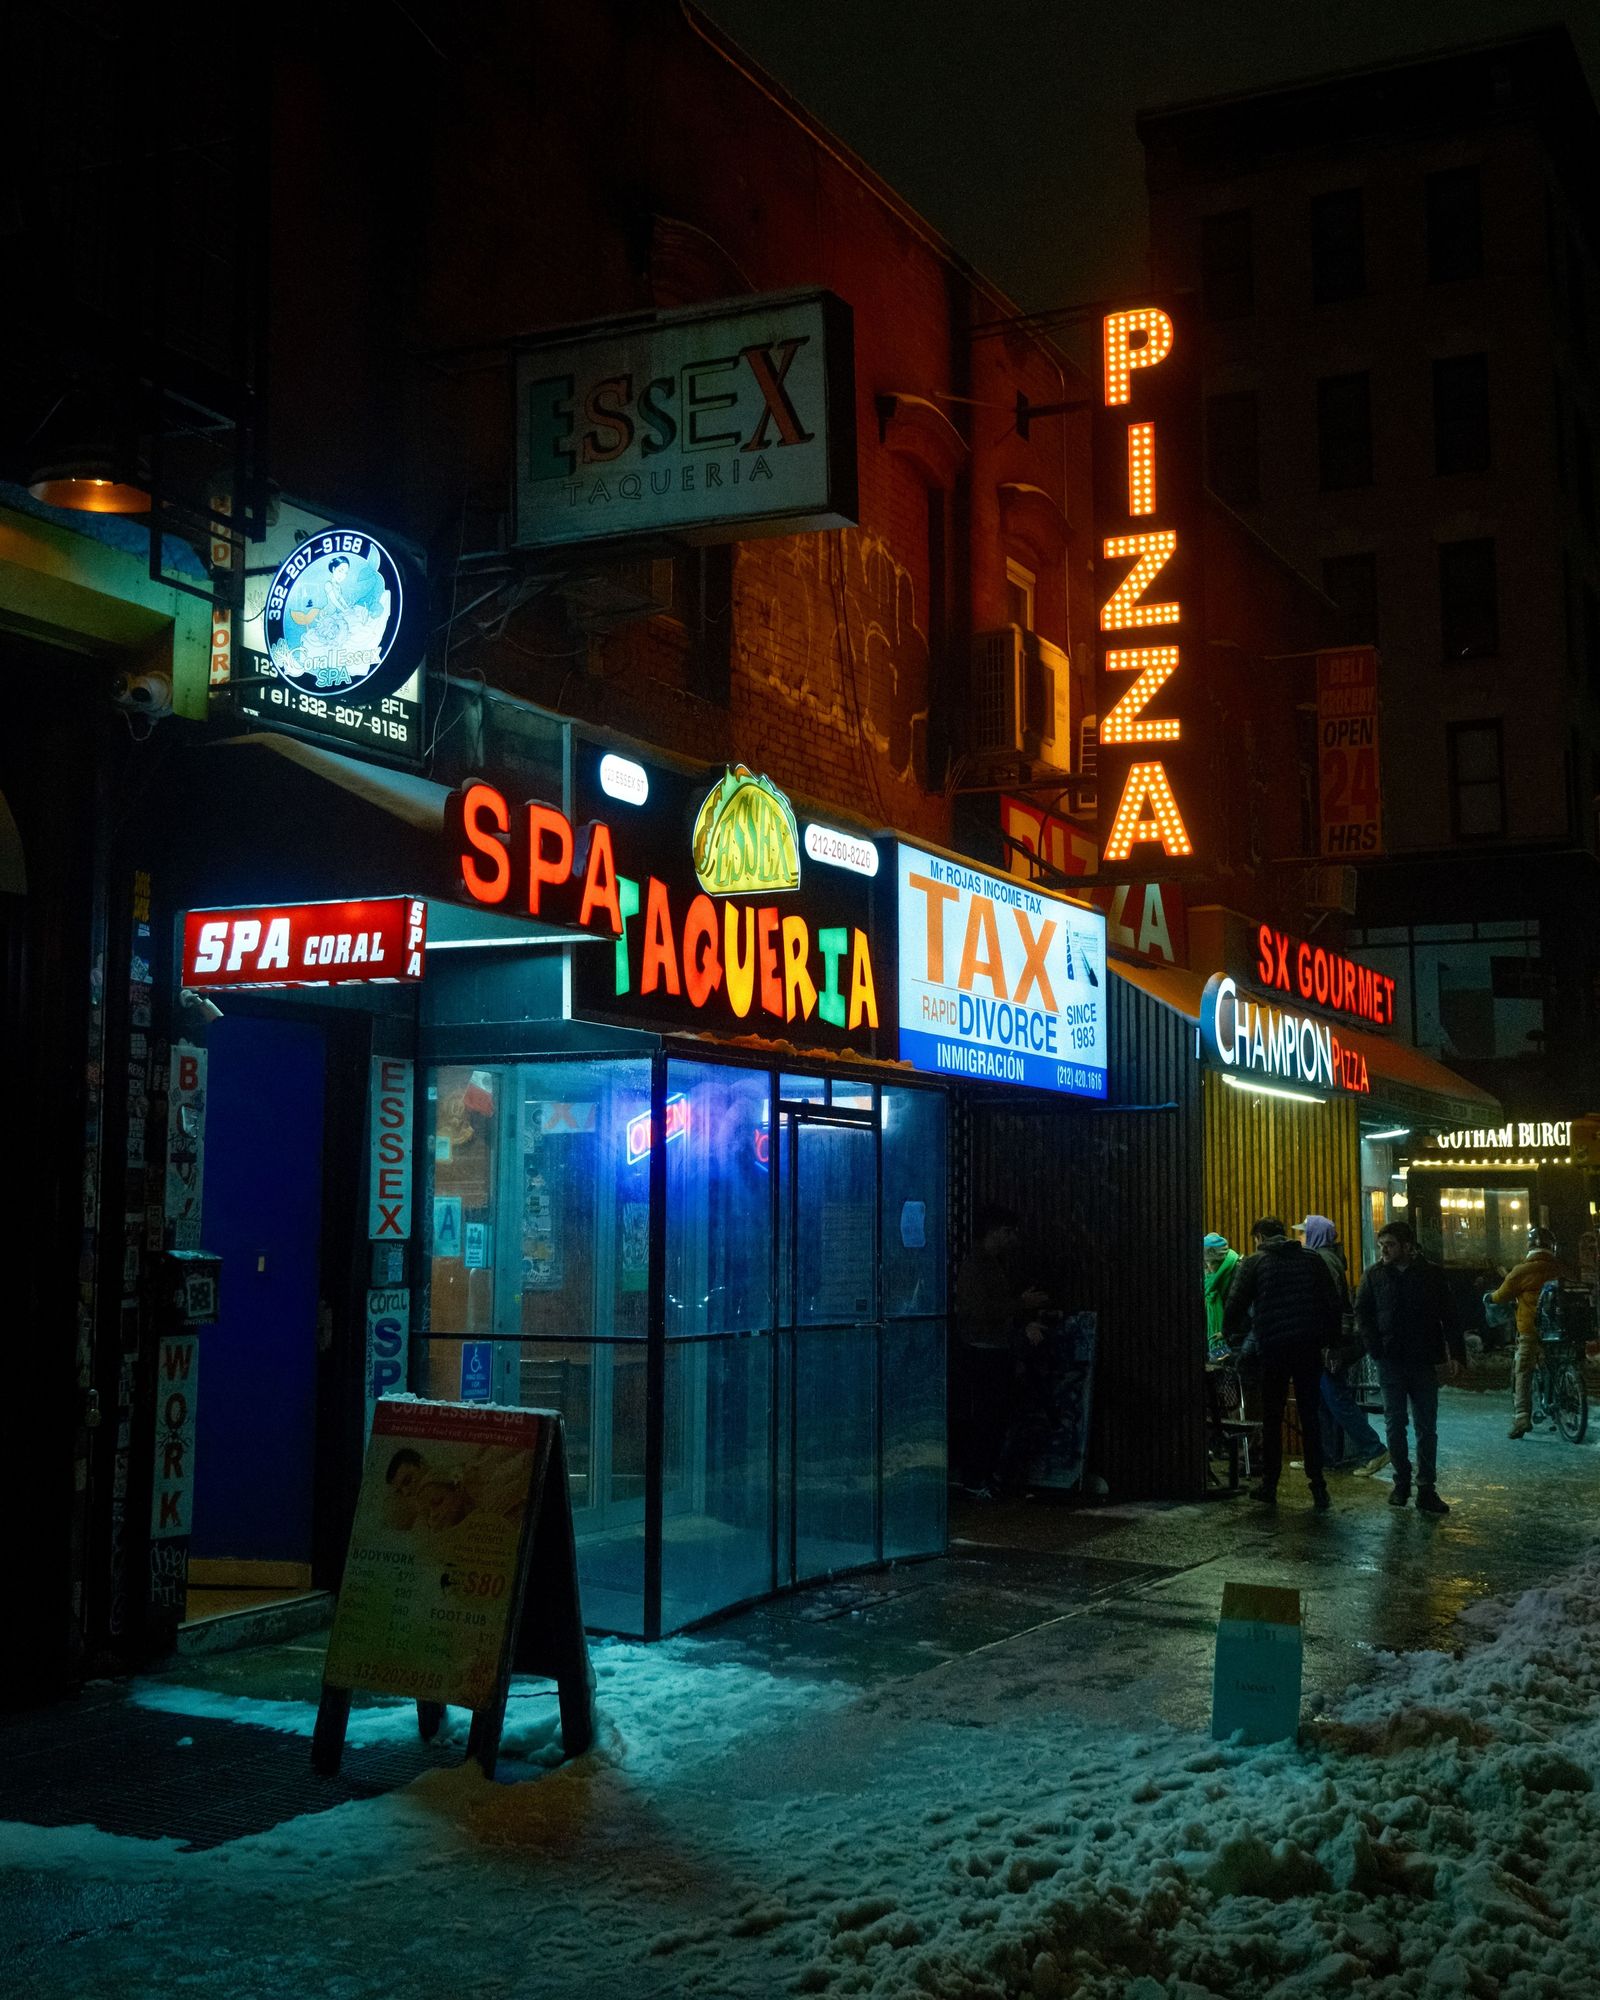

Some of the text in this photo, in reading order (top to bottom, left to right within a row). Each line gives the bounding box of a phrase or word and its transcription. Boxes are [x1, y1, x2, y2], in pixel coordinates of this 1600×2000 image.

[528, 336, 815, 482] ESSEX
[564, 455, 773, 507] TAQUERIA
[269, 536, 362, 620] 332-207-9158
[1100, 308, 1193, 860] PIZZA
[316, 666, 352, 687] SPA
[1323, 718, 1373, 747] OPEN
[1323, 749, 1377, 823] 24
[461, 784, 623, 935] SPA
[714, 790, 792, 887] ESSEX
[812, 833, 871, 868] 212-260-8226
[1328, 823, 1377, 851] HRS
[930, 860, 1042, 915] Mr ROJAS INCOME TAX
[194, 917, 384, 973] SPA CORAL
[407, 901, 424, 977] SPA
[615, 875, 879, 1030] TAQUERIA
[909, 872, 1059, 1013] TAX
[1259, 924, 1395, 1025] SX GOURMET
[922, 993, 1058, 1054] RAPID DIVORCE
[1066, 1003, 1097, 1026] SINCE
[1071, 1028, 1095, 1050] 1983
[1215, 977, 1370, 1094] CHAMPION PIZZA
[937, 1042, 1024, 1081] INMIGRACIÓN
[1057, 1065, 1074, 1086] (212)
[375, 1061, 405, 1235] ESSEX
[439, 1205, 456, 1240] A
[159, 1345, 192, 1528] WORK
[353, 1548, 416, 1566] BODYWORK
[465, 1572, 506, 1597] $80
[430, 1608, 487, 1626] FOOT RUB
